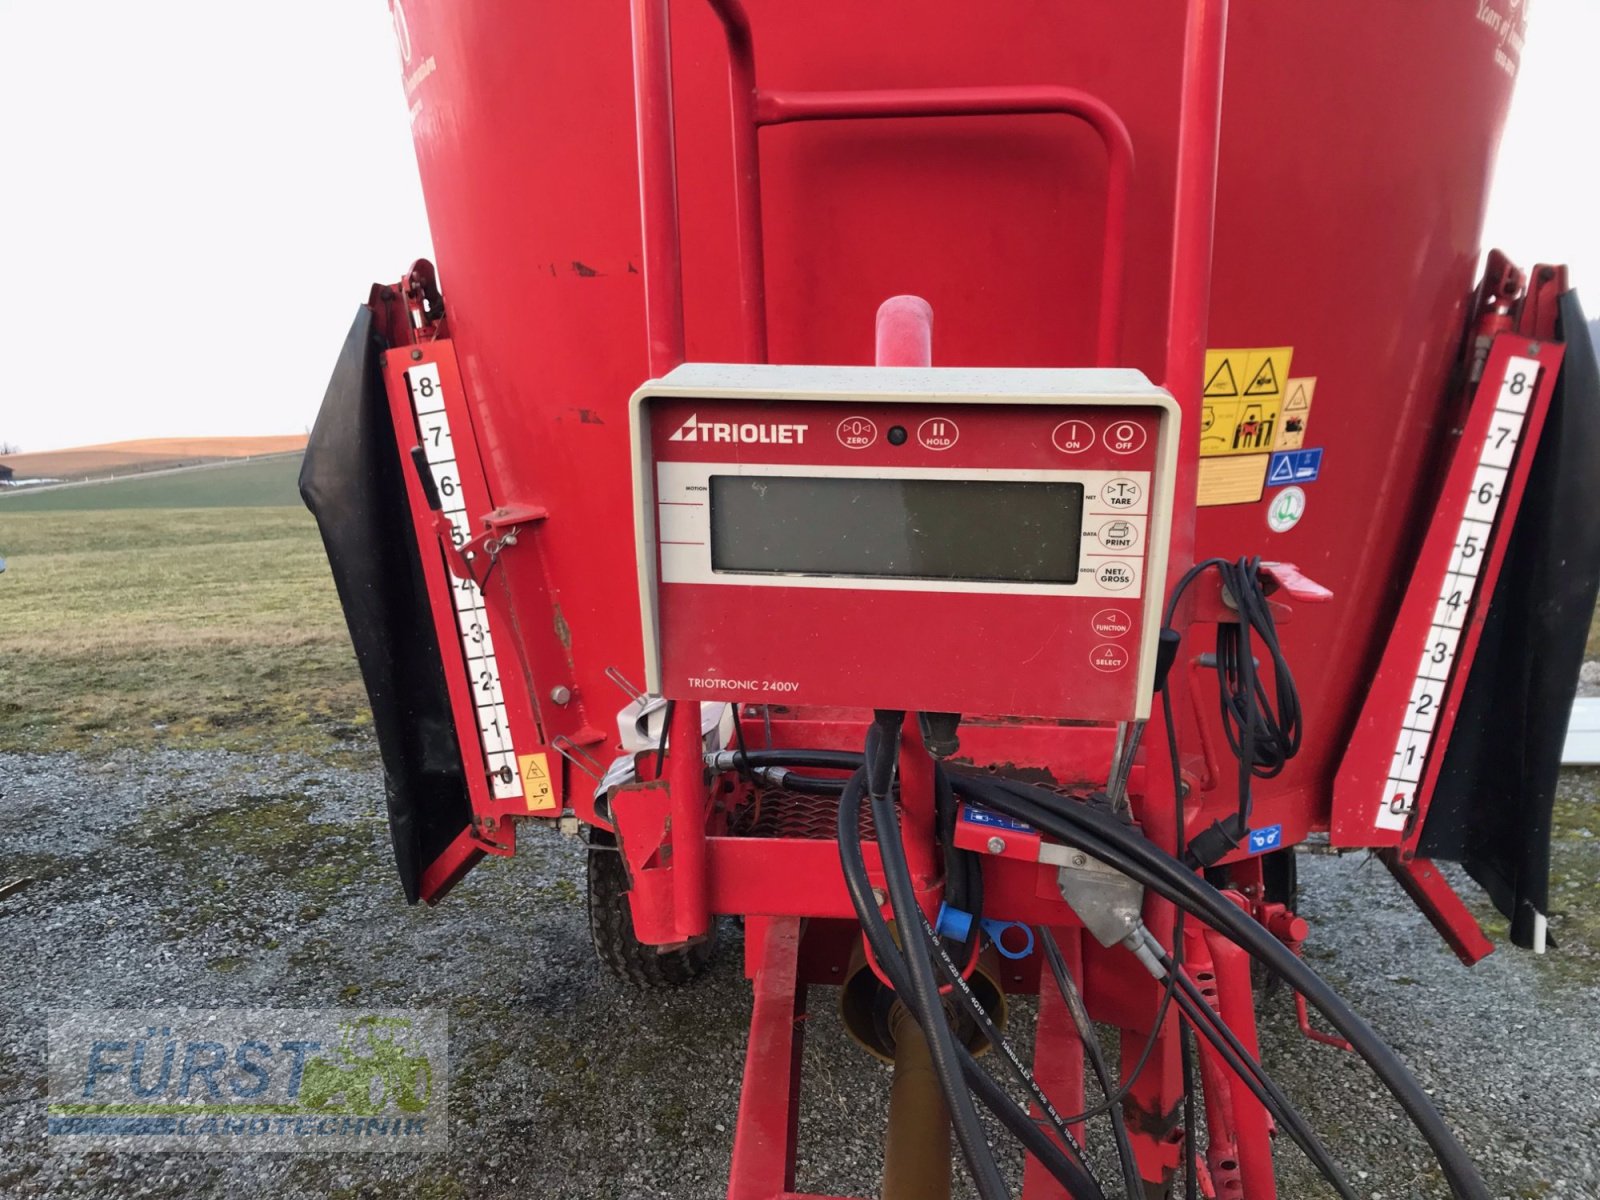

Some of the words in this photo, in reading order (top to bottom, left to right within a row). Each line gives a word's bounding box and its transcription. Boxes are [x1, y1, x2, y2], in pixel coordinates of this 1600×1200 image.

[419, 377, 434, 397] 8
[1509, 372, 1526, 395] 8
[428, 426, 442, 447] 7
[698, 422, 808, 444] TRIOLIET
[926, 437, 950, 446] HOLD
[1494, 426, 1511, 450] 7
[1065, 441, 1081, 449] ON
[1115, 442, 1133, 450] OFF
[440, 476, 455, 496] 6
[1477, 482, 1494, 504] 6
[451, 526, 465, 546] 5
[1461, 536, 1478, 559] 5
[1105, 568, 1127, 576] NET/
[1447, 591, 1462, 610] 4
[470, 622, 485, 644] 3
[1096, 624, 1127, 632] FUNCTION
[1431, 642, 1447, 664] 3
[479, 671, 495, 691] 2
[688, 678, 759, 690] TRIOTRONIC
[762, 681, 799, 692] 2400V
[1416, 694, 1433, 715] 2
[490, 718, 501, 738] 1
[1406, 745, 1417, 766] 1
[500, 765, 513, 784] 0
